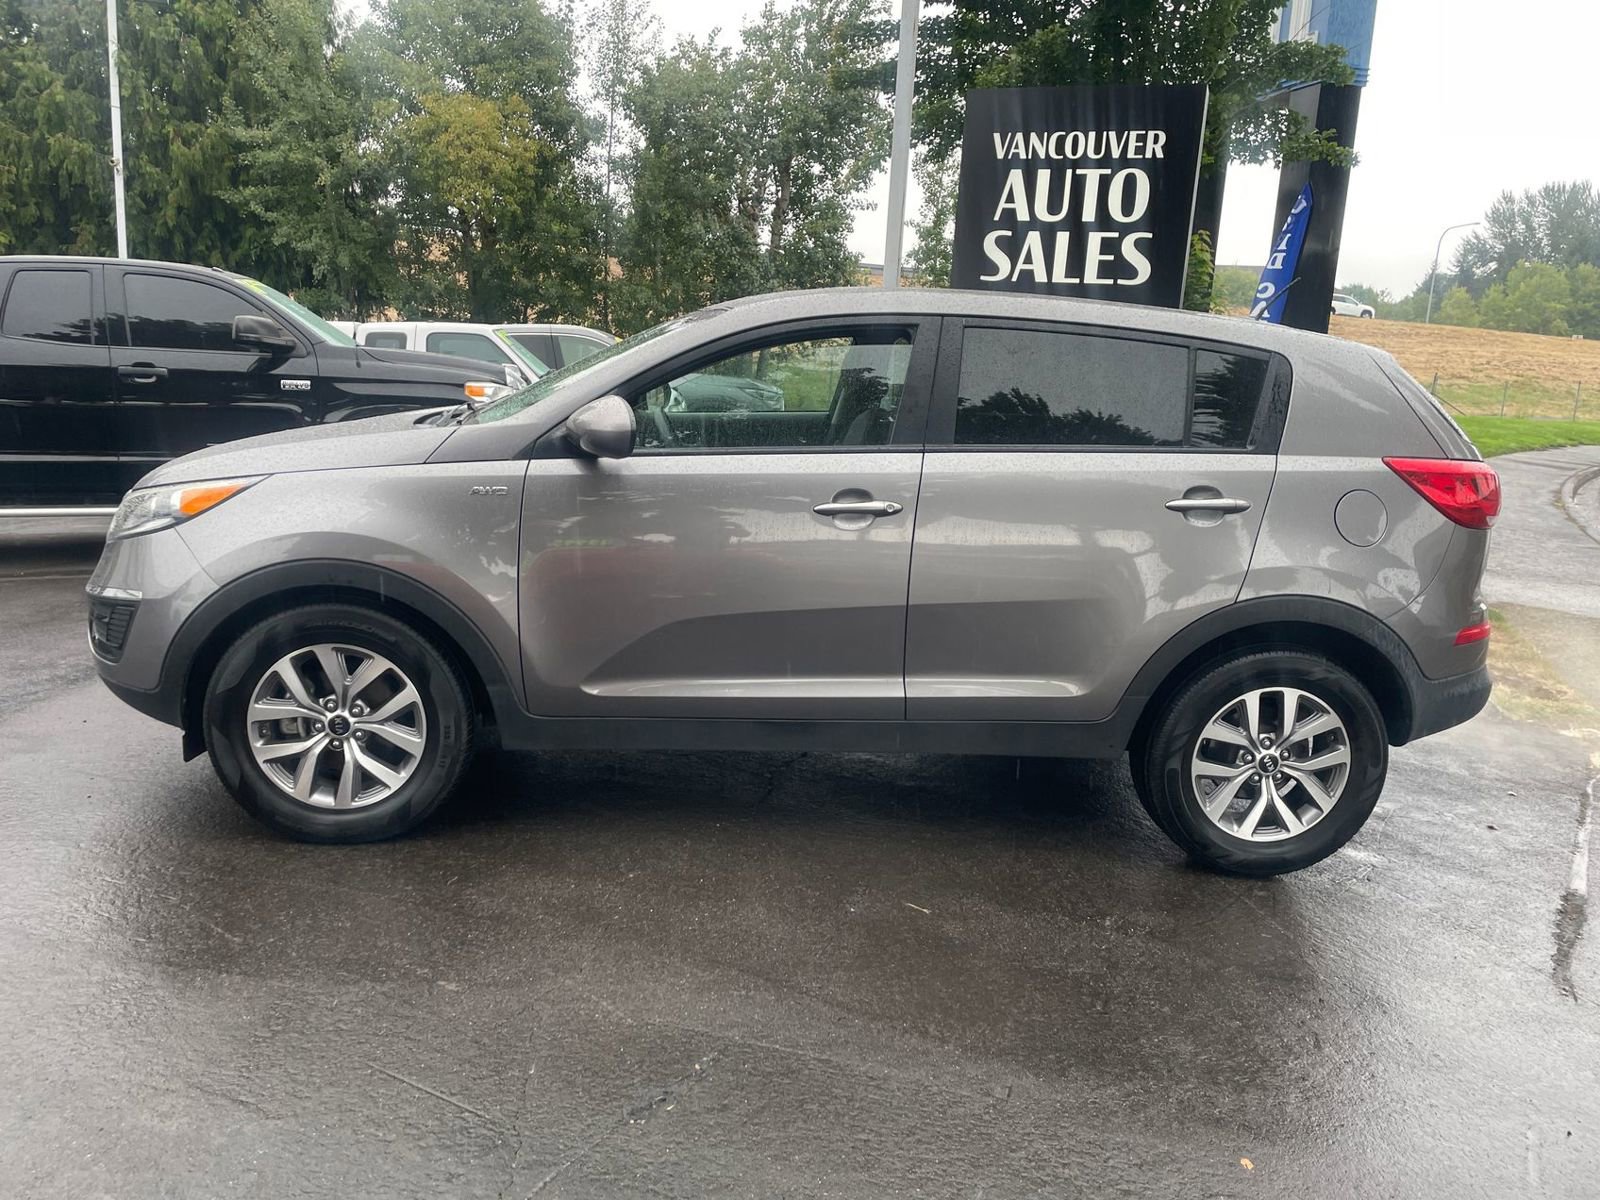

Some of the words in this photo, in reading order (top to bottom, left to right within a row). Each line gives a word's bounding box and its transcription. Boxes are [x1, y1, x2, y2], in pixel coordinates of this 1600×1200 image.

[993, 130, 1167, 160] VANCOUVER
[993, 167, 1151, 223] AUTO
[979, 229, 1154, 286] SALES
[469, 486, 508, 496] AWD
